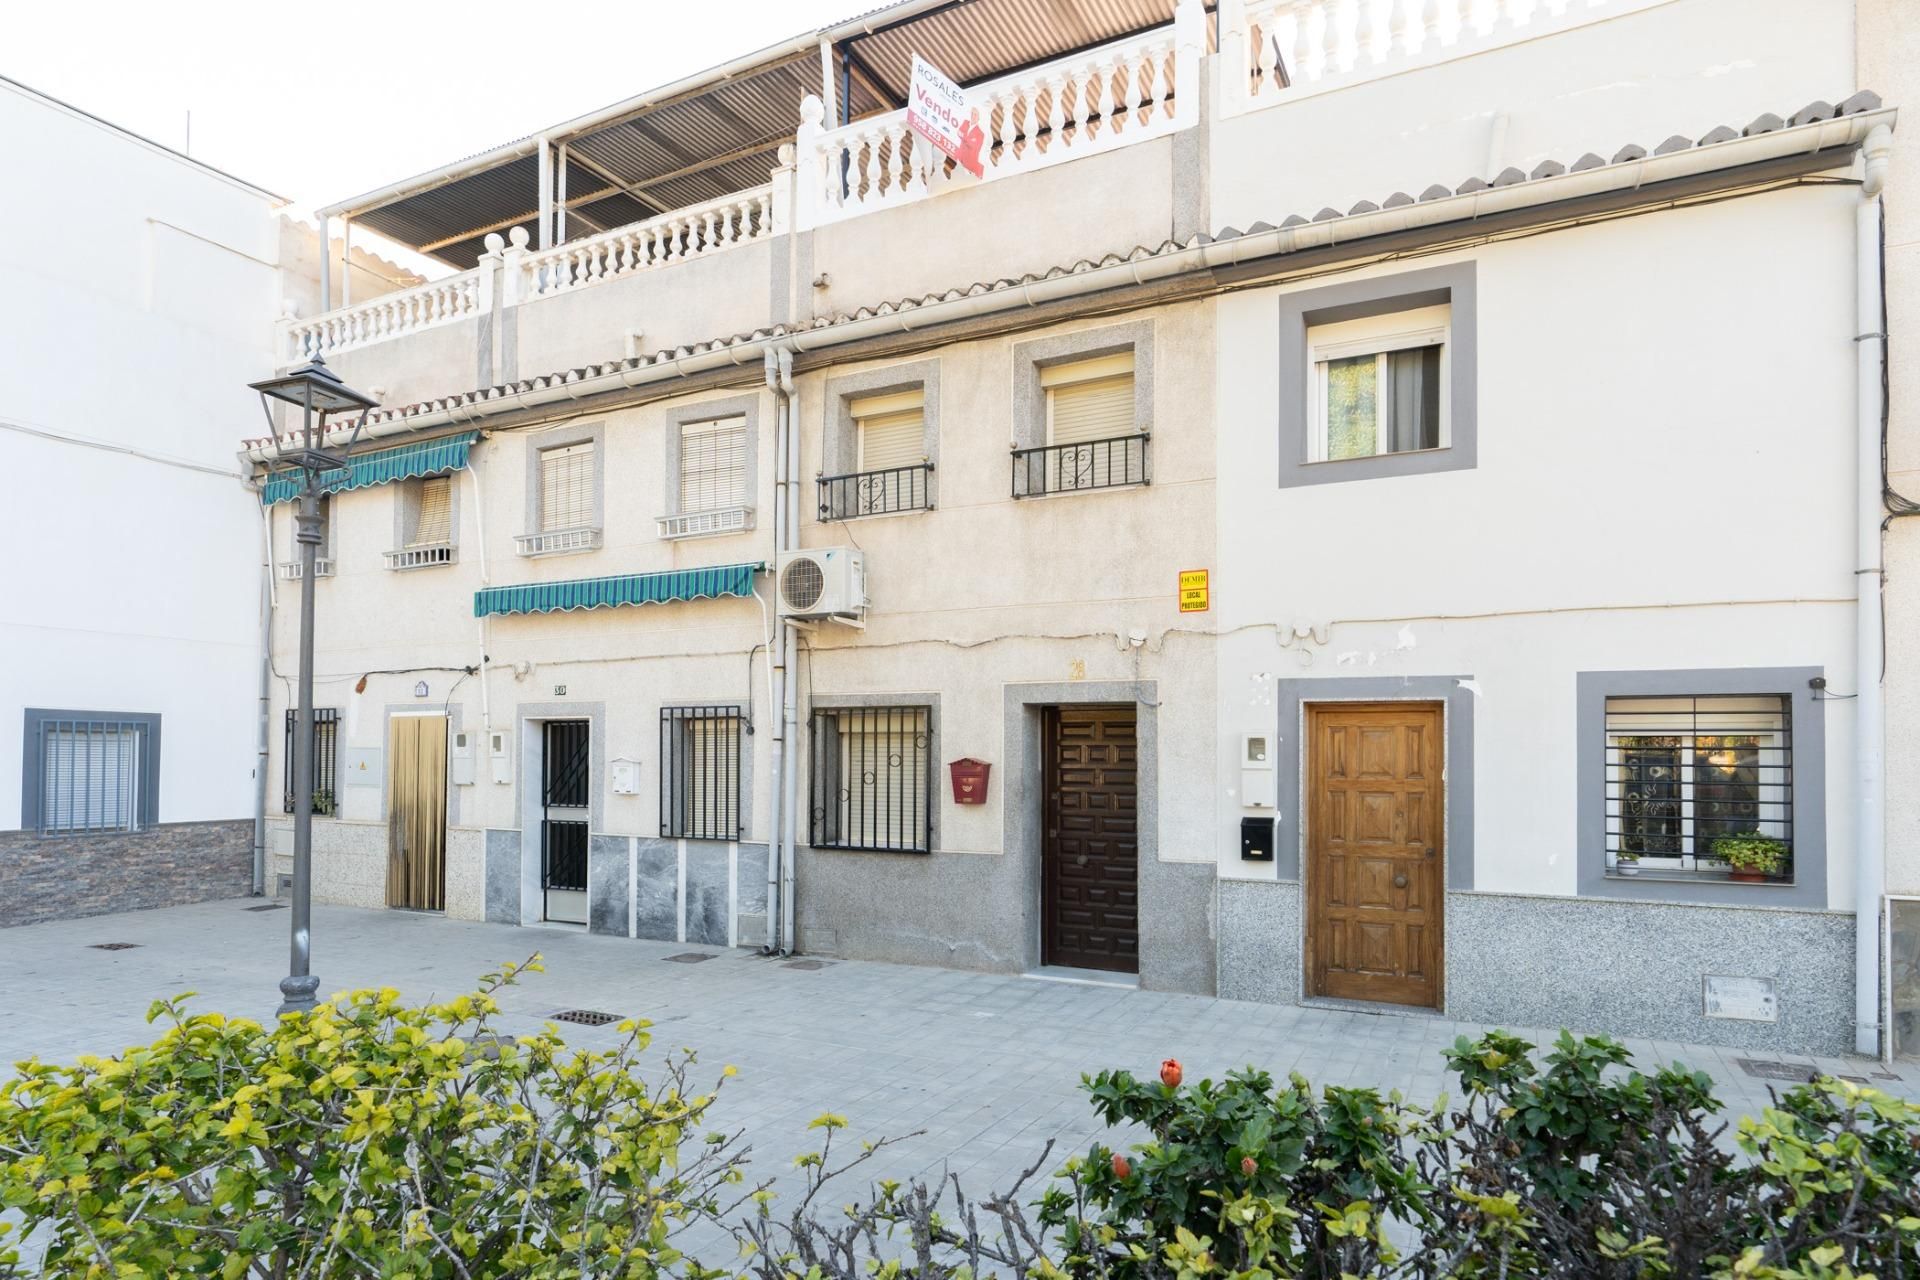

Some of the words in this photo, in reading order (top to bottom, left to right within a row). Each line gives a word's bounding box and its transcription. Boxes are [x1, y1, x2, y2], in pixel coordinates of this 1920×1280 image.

[916, 83, 959, 128] Vendo
[918, 64, 964, 106] ROSALES
[1182, 601, 1206, 609] PROTEGIDO
